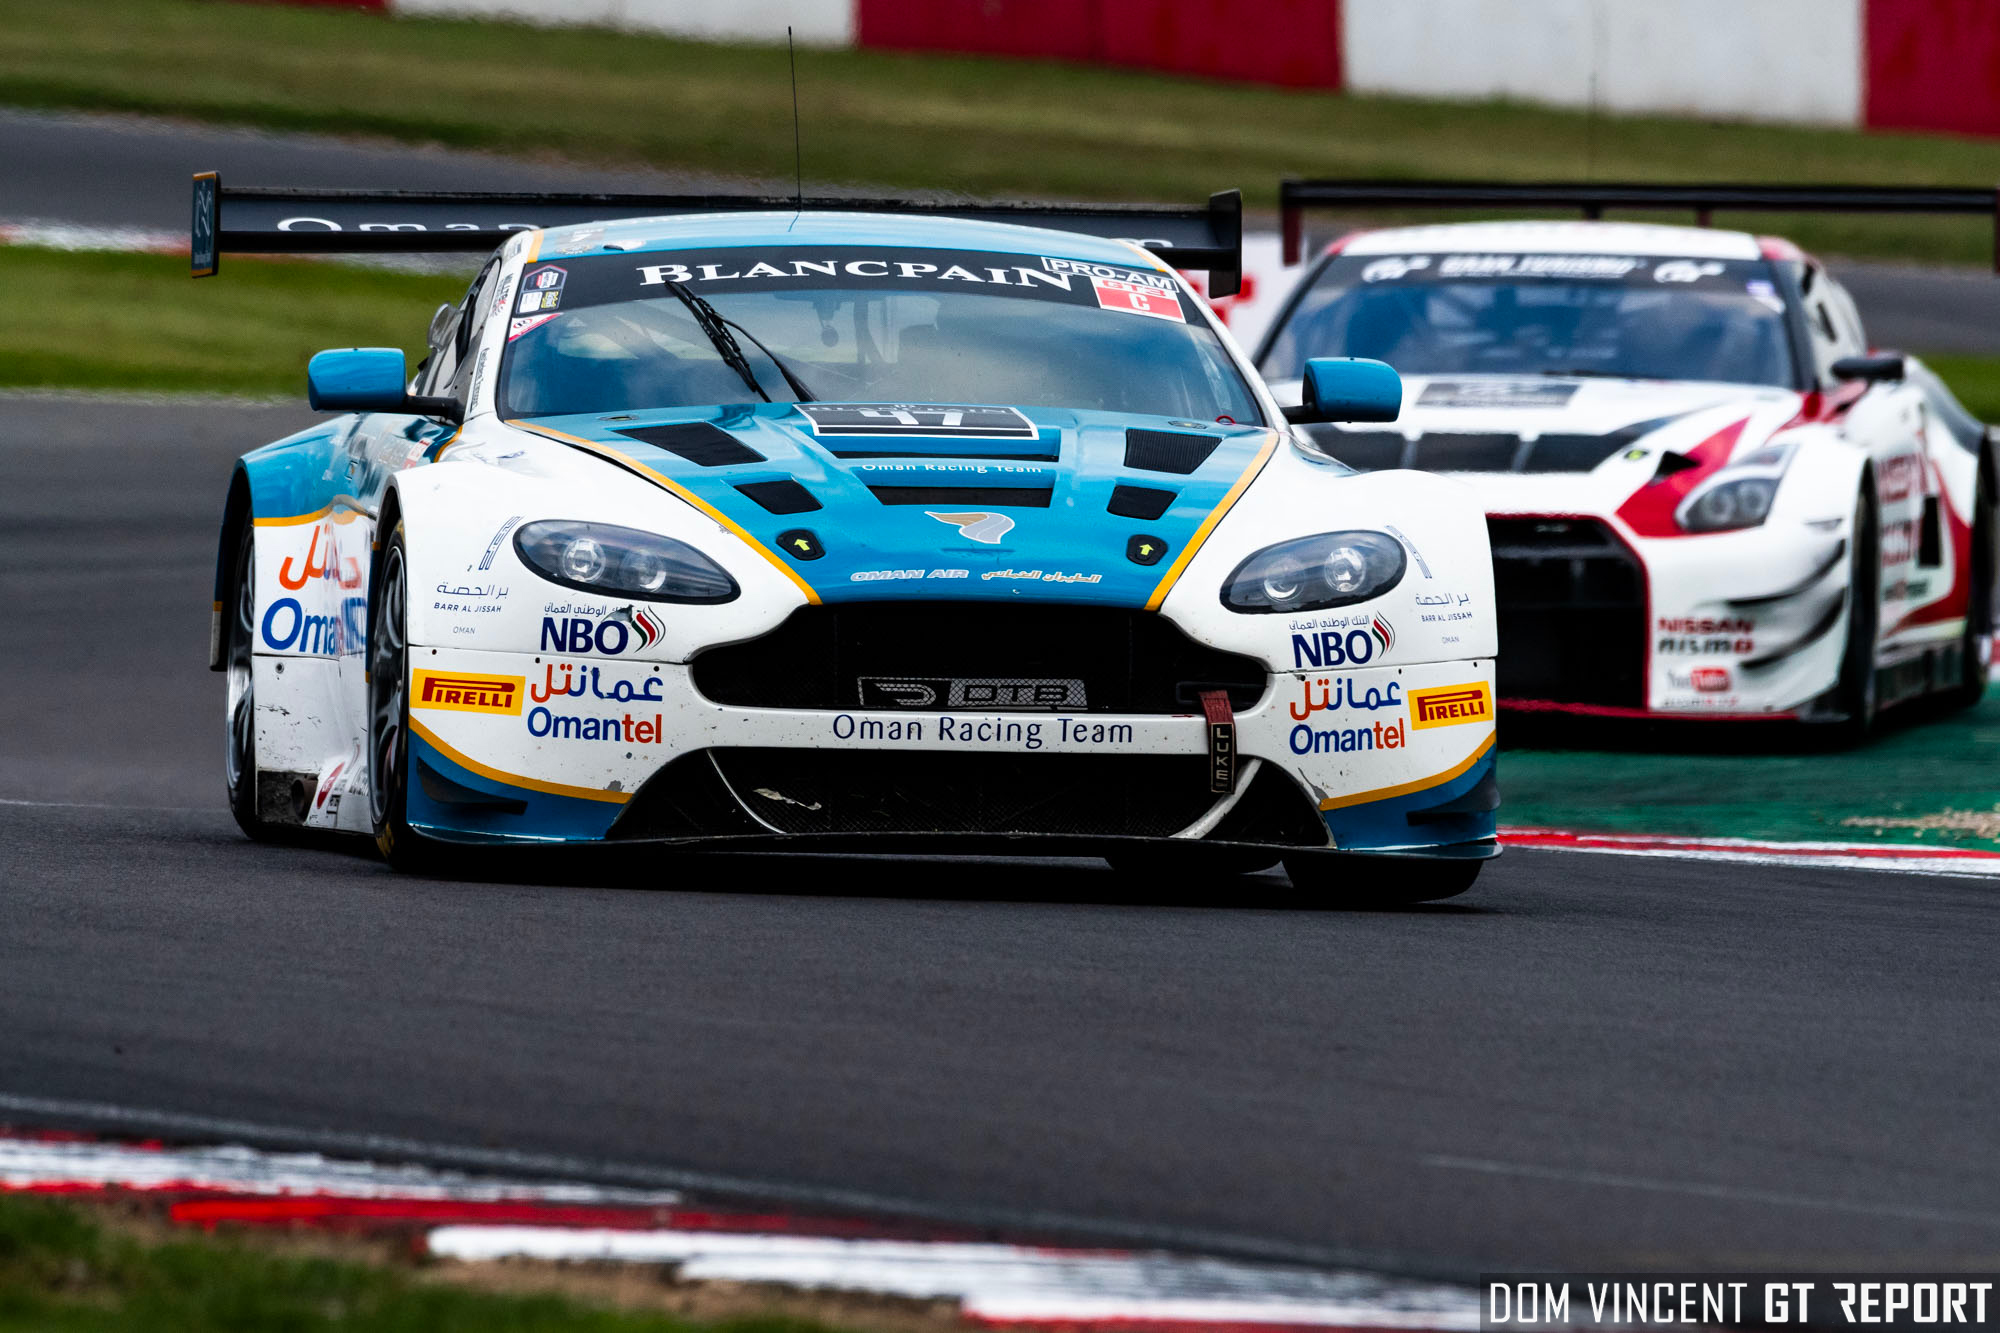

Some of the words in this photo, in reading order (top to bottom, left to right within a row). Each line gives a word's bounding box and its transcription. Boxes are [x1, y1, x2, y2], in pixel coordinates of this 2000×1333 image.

[636, 260, 1072, 292] BLANCPAIN
[1050, 259, 1173, 291] PRO-AM
[1128, 293, 1150, 311] C
[858, 410, 964, 427] 47
[861, 463, 917, 472] Oman
[924, 463, 988, 474] Racing
[996, 464, 1042, 474] Team
[849, 569, 926, 582] OMAN
[926, 569, 970, 580] AIR
[433, 602, 460, 612] BARR
[461, 604, 472, 613] AL
[474, 605, 502, 613] JISSAH
[452, 625, 476, 635] OMAN
[540, 616, 630, 656] NBO
[1291, 629, 1374, 669] NBO
[421, 676, 516, 709] PIRELLI
[530, 663, 664, 704] عمانتل
[1289, 677, 1402, 721] عمانتل
[1416, 689, 1486, 723] PIRELLI
[527, 706, 663, 744] Omantel
[832, 713, 923, 742] Oman
[938, 715, 1043, 750] Racing
[1057, 717, 1134, 744] Team
[1289, 717, 1406, 756] Omantel
